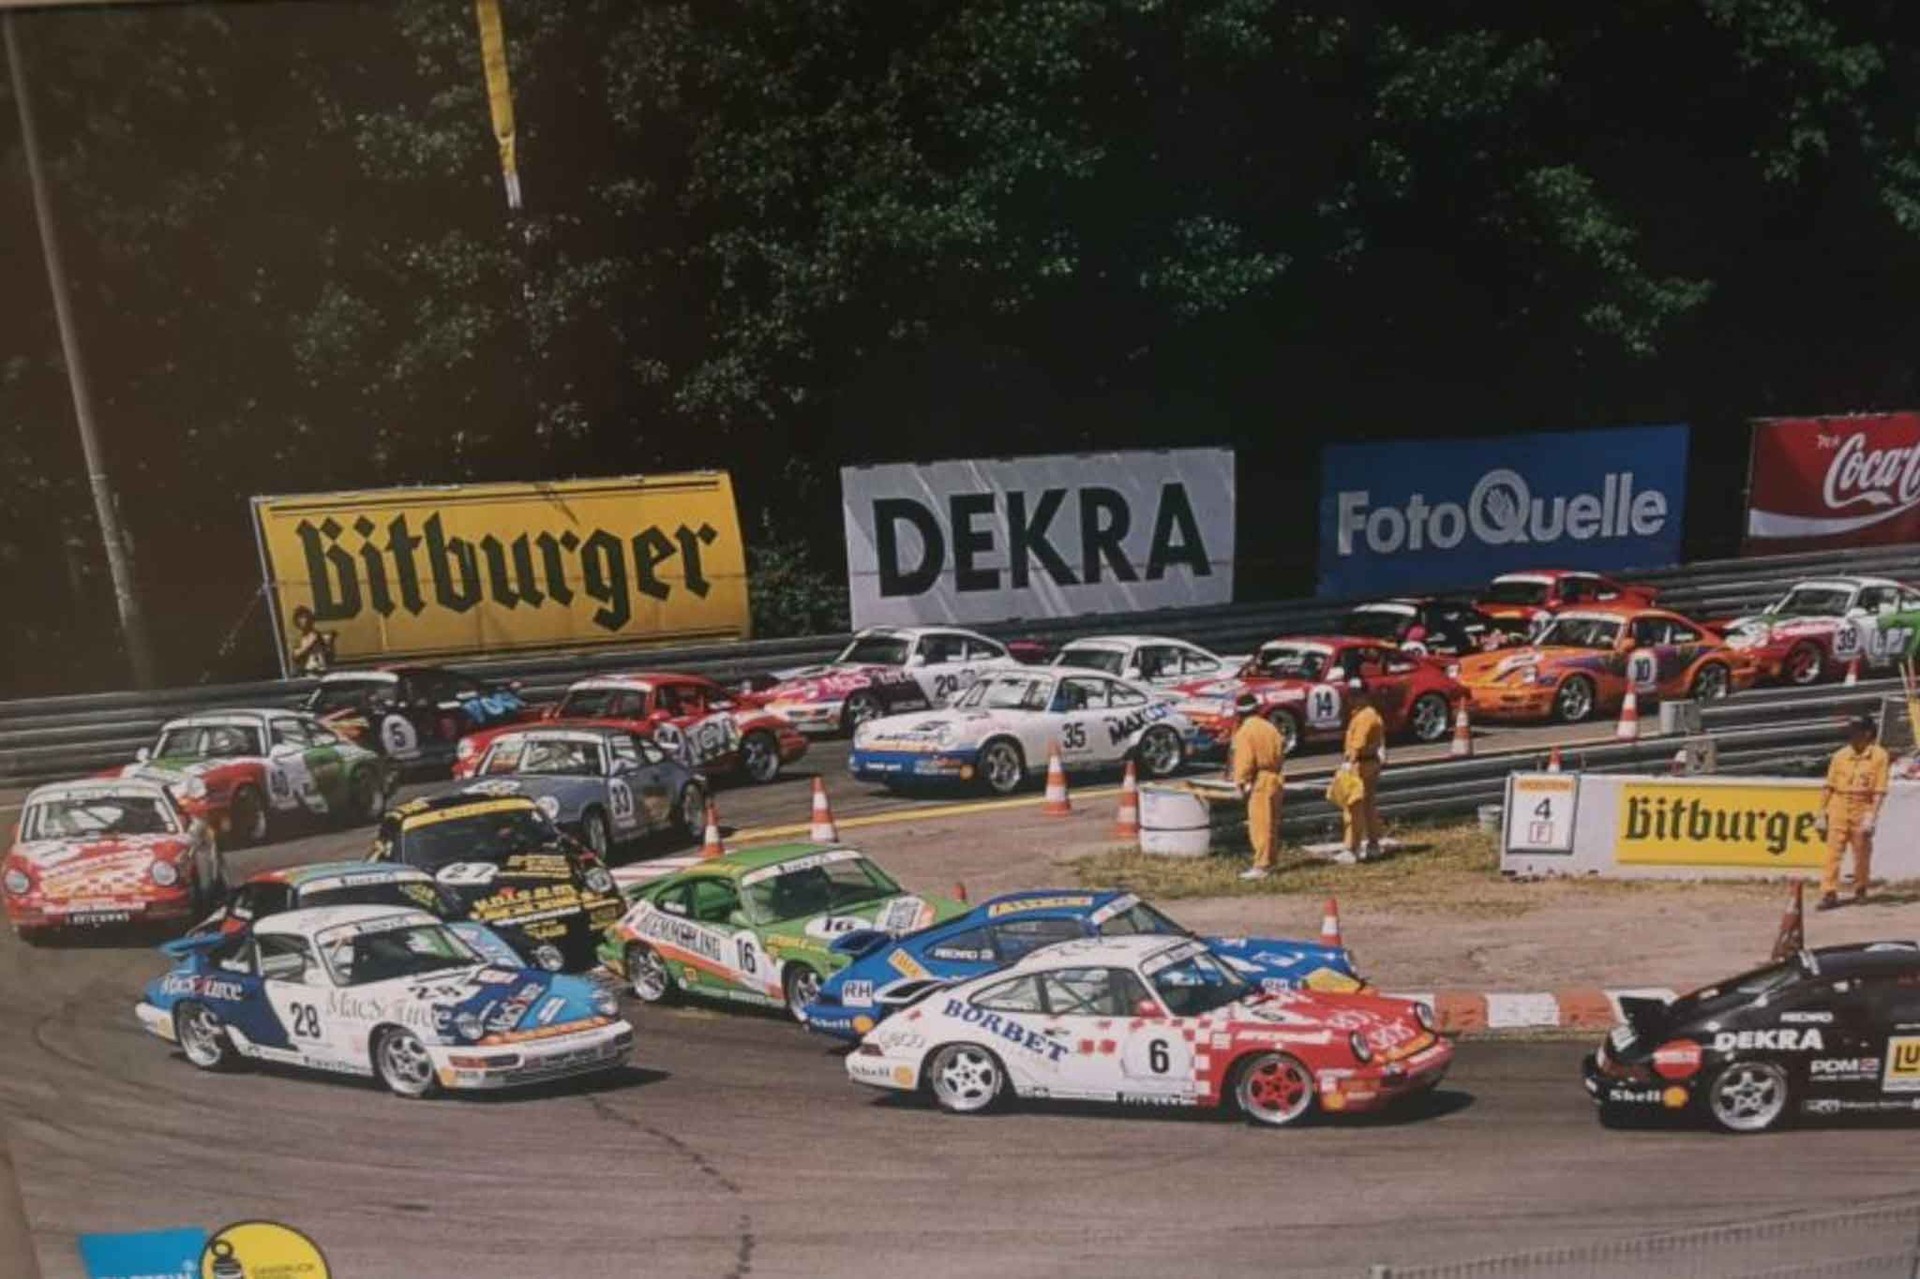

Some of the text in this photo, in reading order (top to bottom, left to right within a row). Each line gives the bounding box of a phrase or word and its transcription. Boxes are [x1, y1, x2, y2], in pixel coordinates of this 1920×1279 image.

[1337, 468, 1668, 555] FotoQuelle
[872, 482, 1213, 598] DEKRA
[295, 510, 718, 632] Bitburger
[1839, 628, 1858, 652] 39
[1316, 691, 1333, 717] 14
[390, 722, 406, 747] 5
[1062, 722, 1086, 749] 35
[611, 785, 631, 815] 33
[1535, 798, 1551, 820] 4
[1625, 796, 1829, 855] Bitburge
[737, 938, 756, 974] 16
[844, 985, 873, 999] RH
[290, 1002, 321, 1039] 28
[942, 999, 1069, 1062] BORBET
[1714, 1028, 1824, 1051] DEKRA
[1149, 1038, 1170, 1074] 6
[1609, 1088, 1661, 1102] Shell
